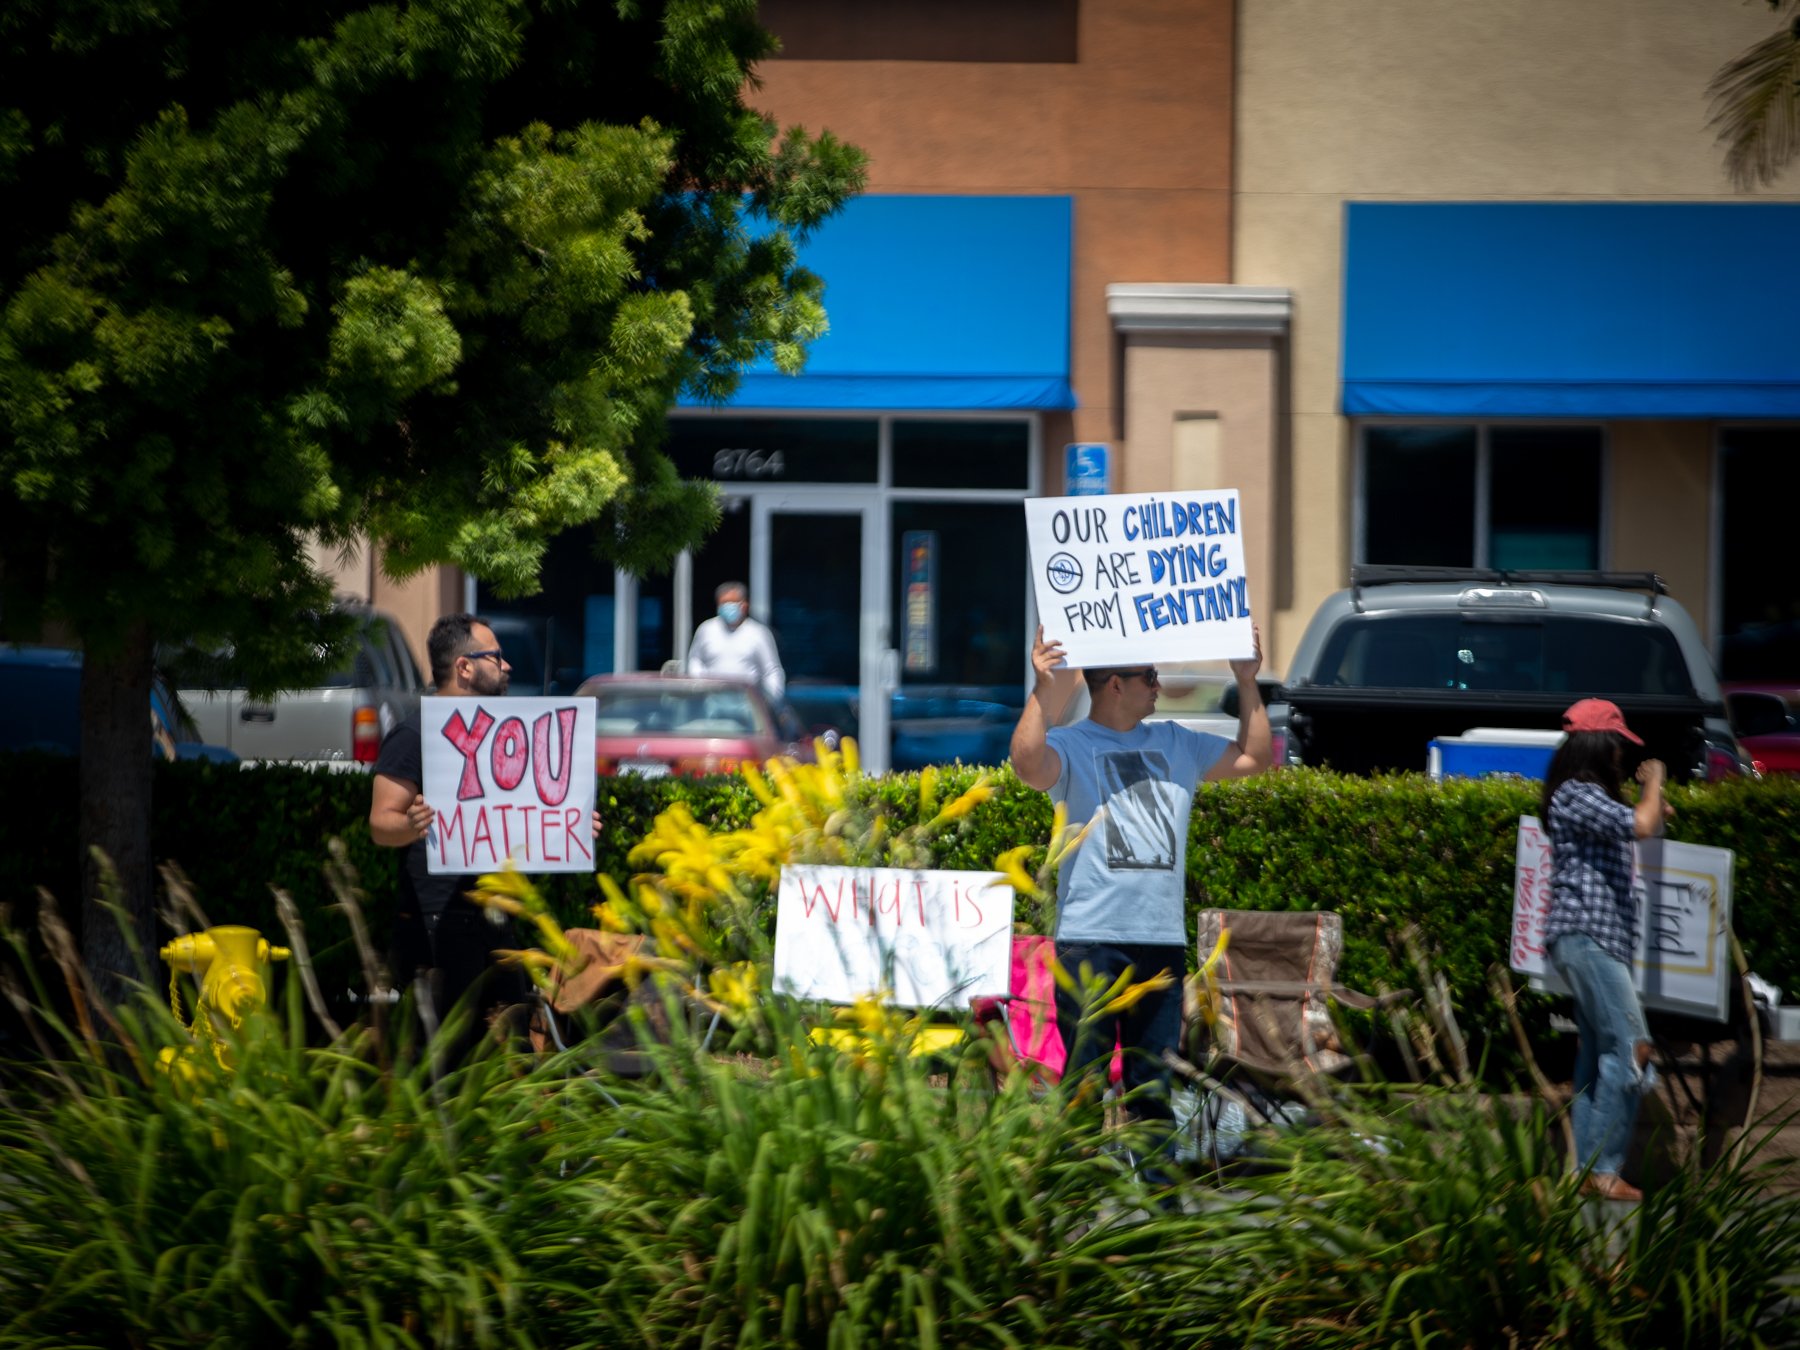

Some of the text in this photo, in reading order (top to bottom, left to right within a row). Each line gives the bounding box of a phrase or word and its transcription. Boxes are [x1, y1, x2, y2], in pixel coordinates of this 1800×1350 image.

[1051, 507, 1109, 544] OUR
[1095, 552, 1141, 590] ARE
[1063, 576, 1250, 638] FROM FENTANYL
[440, 704, 578, 807] YOU
[437, 802, 592, 867] MATTER
[1649, 878, 1697, 958] Find
